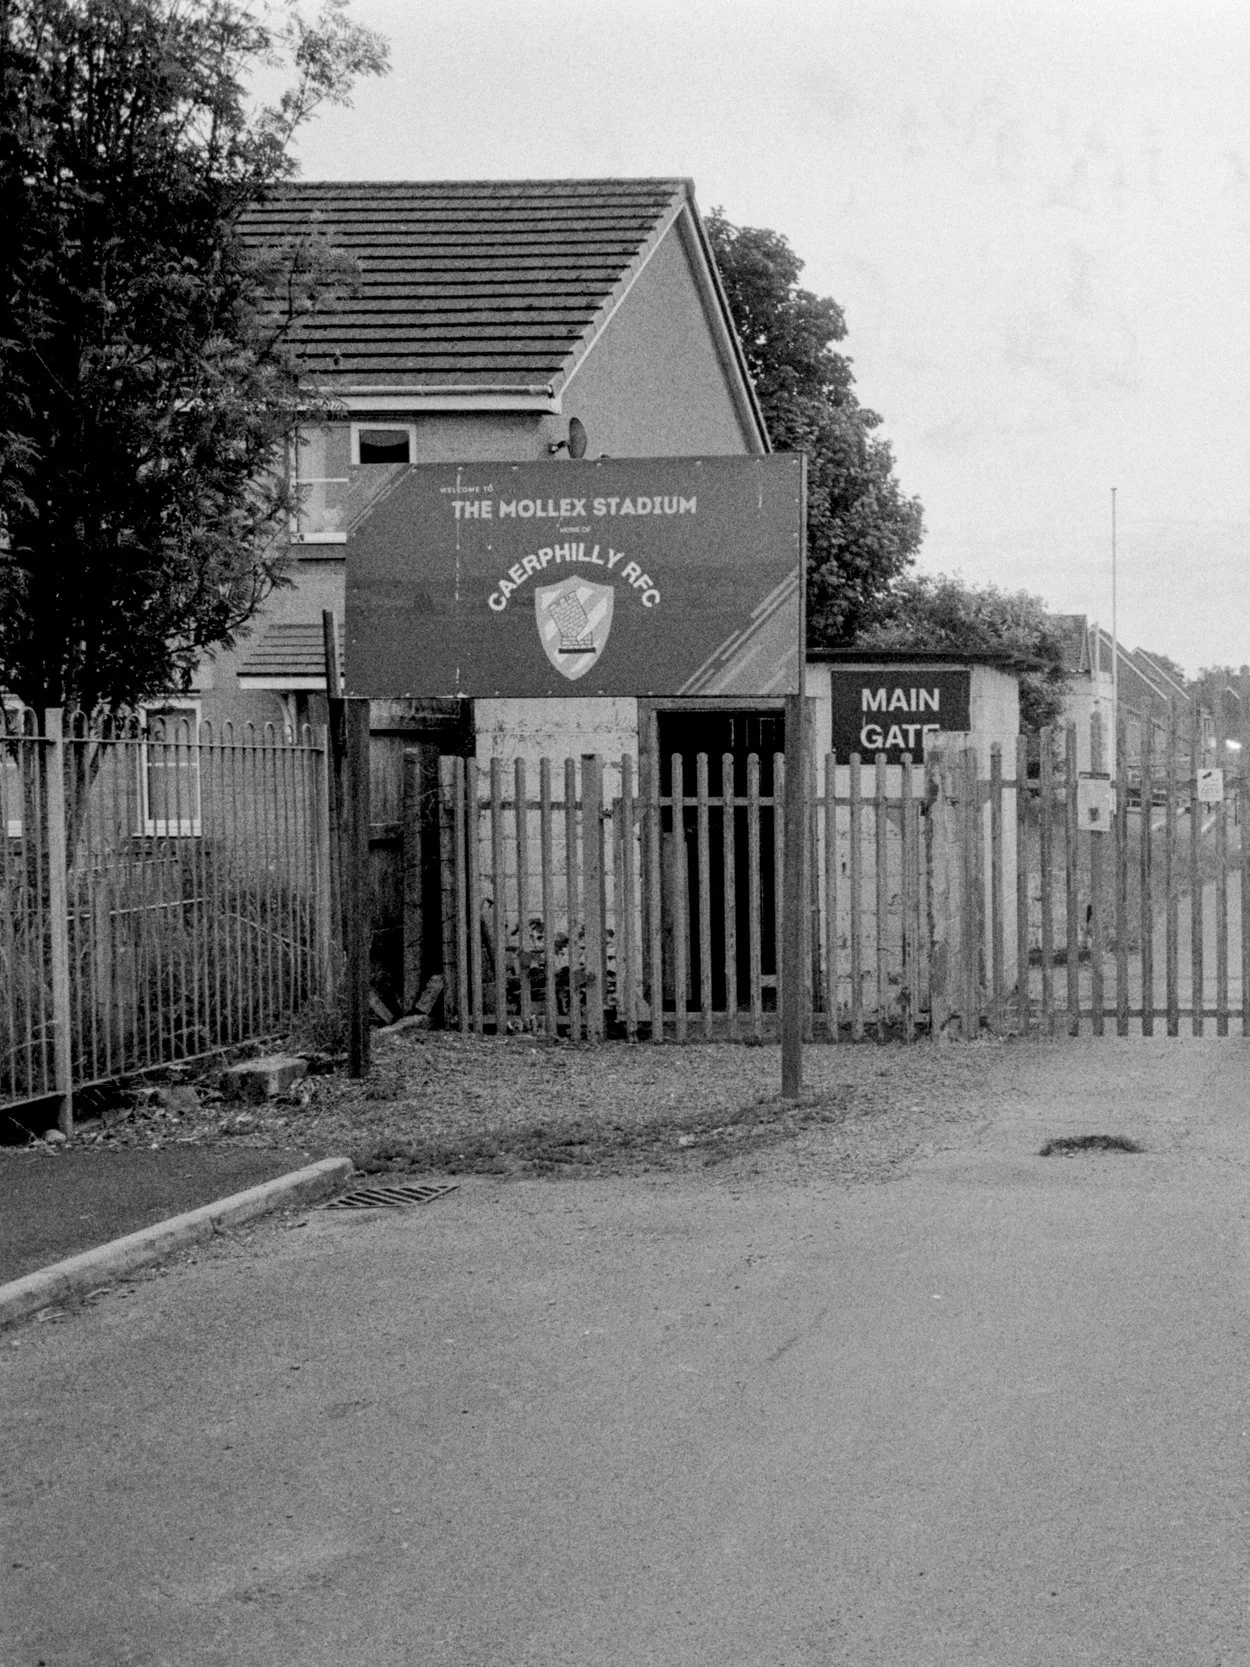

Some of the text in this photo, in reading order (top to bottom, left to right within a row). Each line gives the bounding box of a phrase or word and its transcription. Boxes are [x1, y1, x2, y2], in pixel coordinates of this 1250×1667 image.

[439, 484, 495, 494] WELCOME TO
[451, 495, 698, 519] THE MOLLEX STADIUM
[488, 542, 661, 612] CAERPHILLY RFC
[861, 687, 940, 712] MAIN
